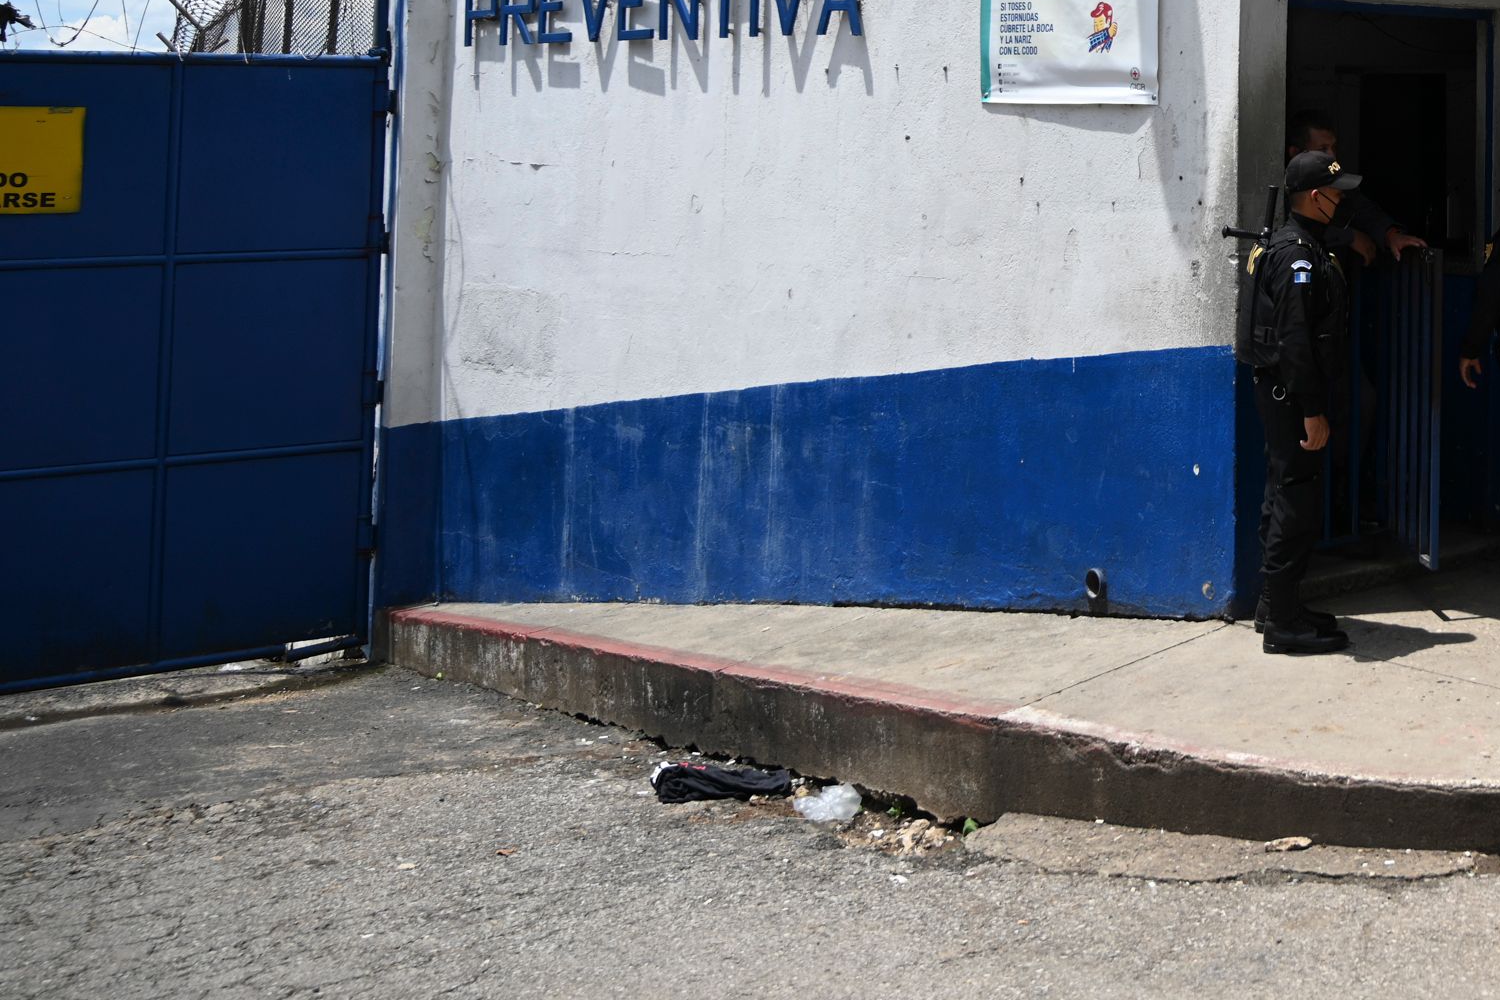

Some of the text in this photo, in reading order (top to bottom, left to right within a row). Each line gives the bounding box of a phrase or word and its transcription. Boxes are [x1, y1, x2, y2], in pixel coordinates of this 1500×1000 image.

[1000, 1, 1032, 11] SI TOSES O
[1000, 12, 1039, 22] ESTORNUDAS
[1000, 22, 1054, 33] CÚBRETE LA BOCA
[999, 34, 1032, 44] Y LA NARIZ
[999, 46, 1038, 56] CON EL CODO
[0, 192, 56, 208] RSE
